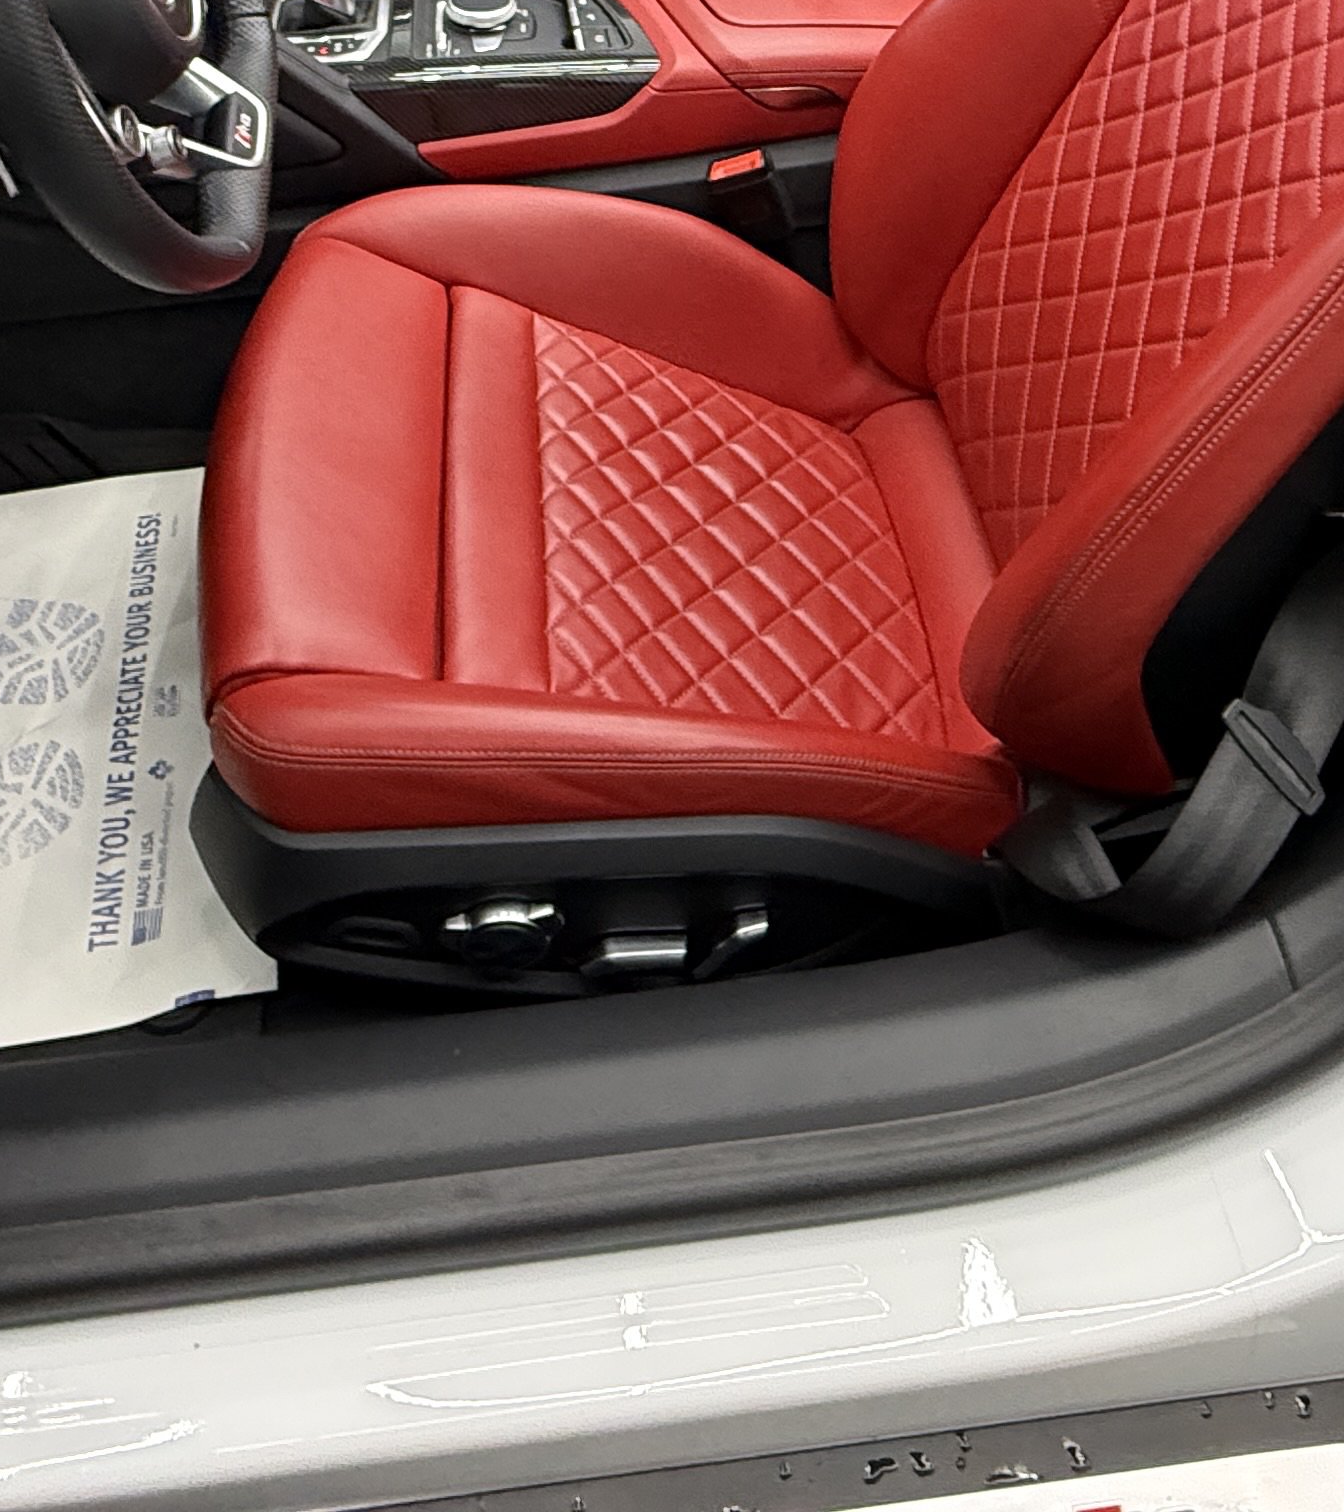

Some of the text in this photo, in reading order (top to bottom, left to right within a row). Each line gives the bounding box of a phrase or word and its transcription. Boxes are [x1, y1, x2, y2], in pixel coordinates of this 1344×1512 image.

[87, 511, 162, 952] THANK YOU, WE APPRECIATE YOUR BUSINESS!
[135, 830, 155, 909] MADE IN USA
